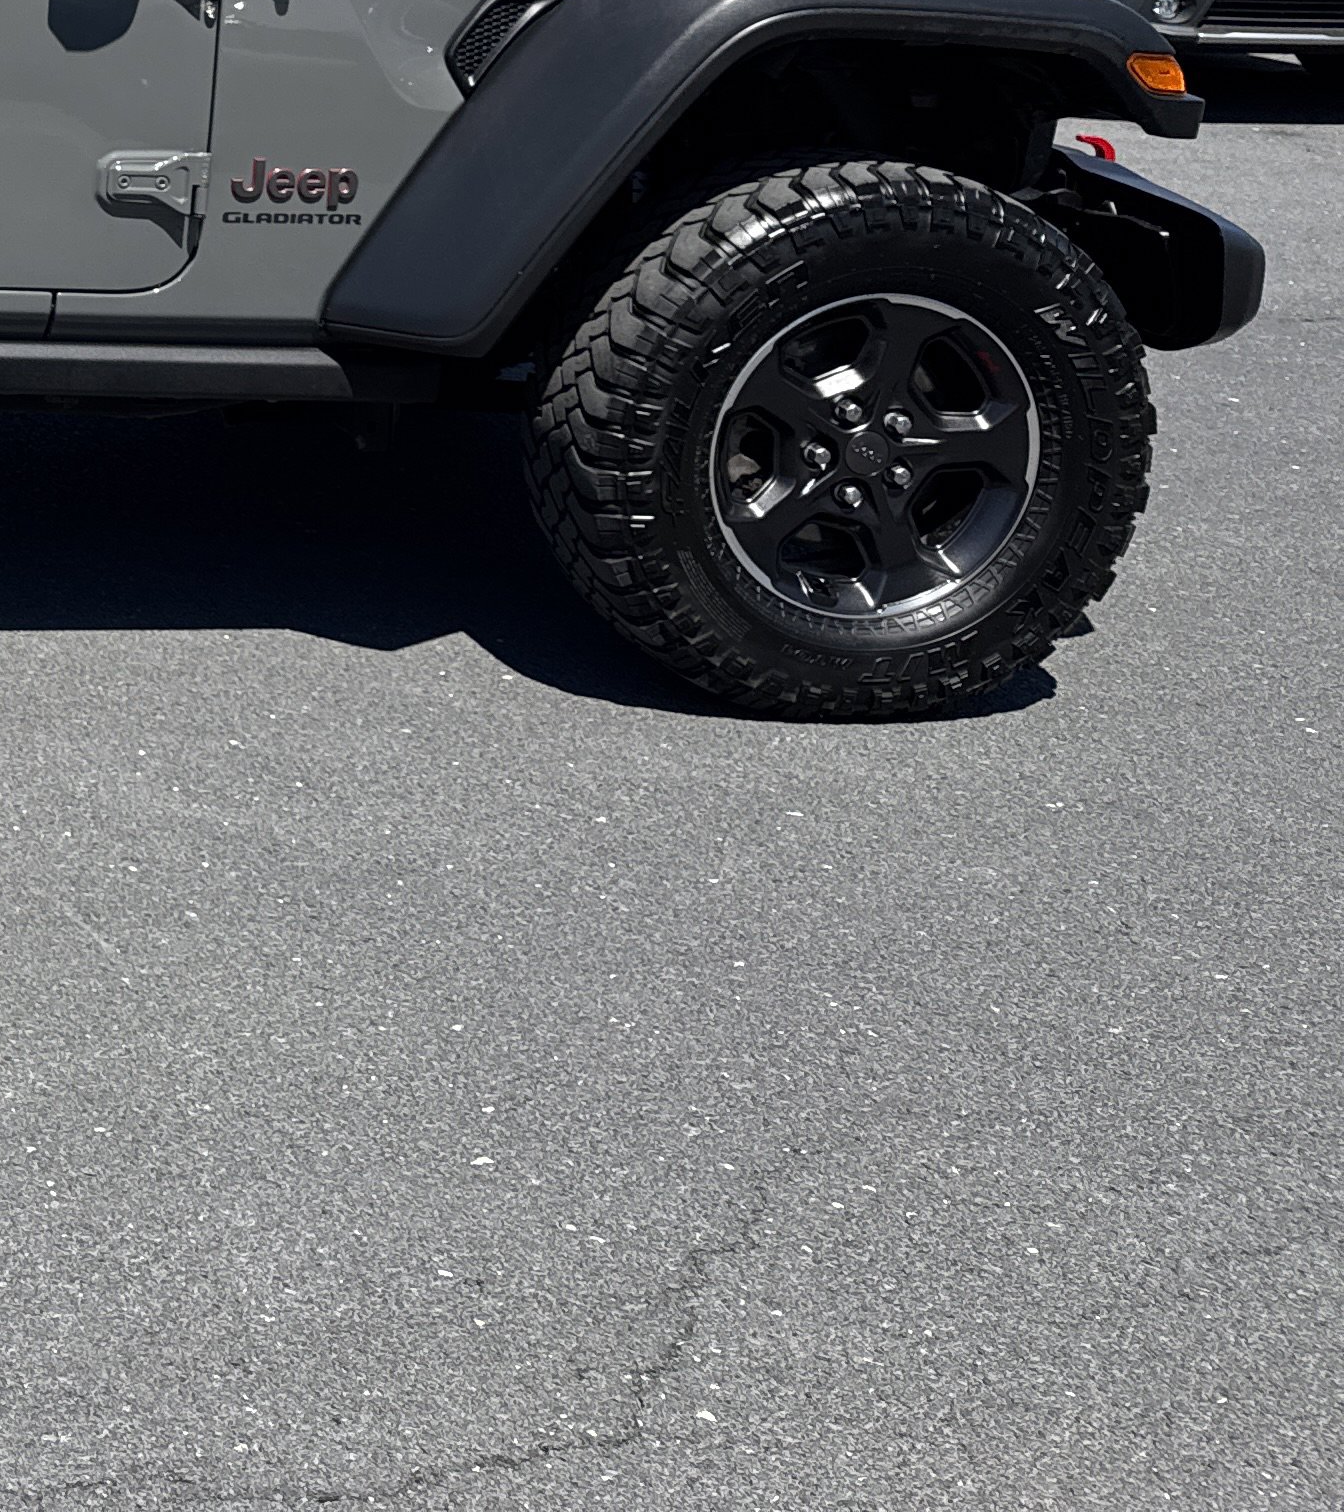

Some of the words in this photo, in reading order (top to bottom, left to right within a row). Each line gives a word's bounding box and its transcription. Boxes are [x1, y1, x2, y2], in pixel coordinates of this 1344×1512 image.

[230, 155, 359, 212] Jeep
[222, 211, 362, 226] GLADIATOR
[1006, 301, 1113, 633] WILDPEAK
